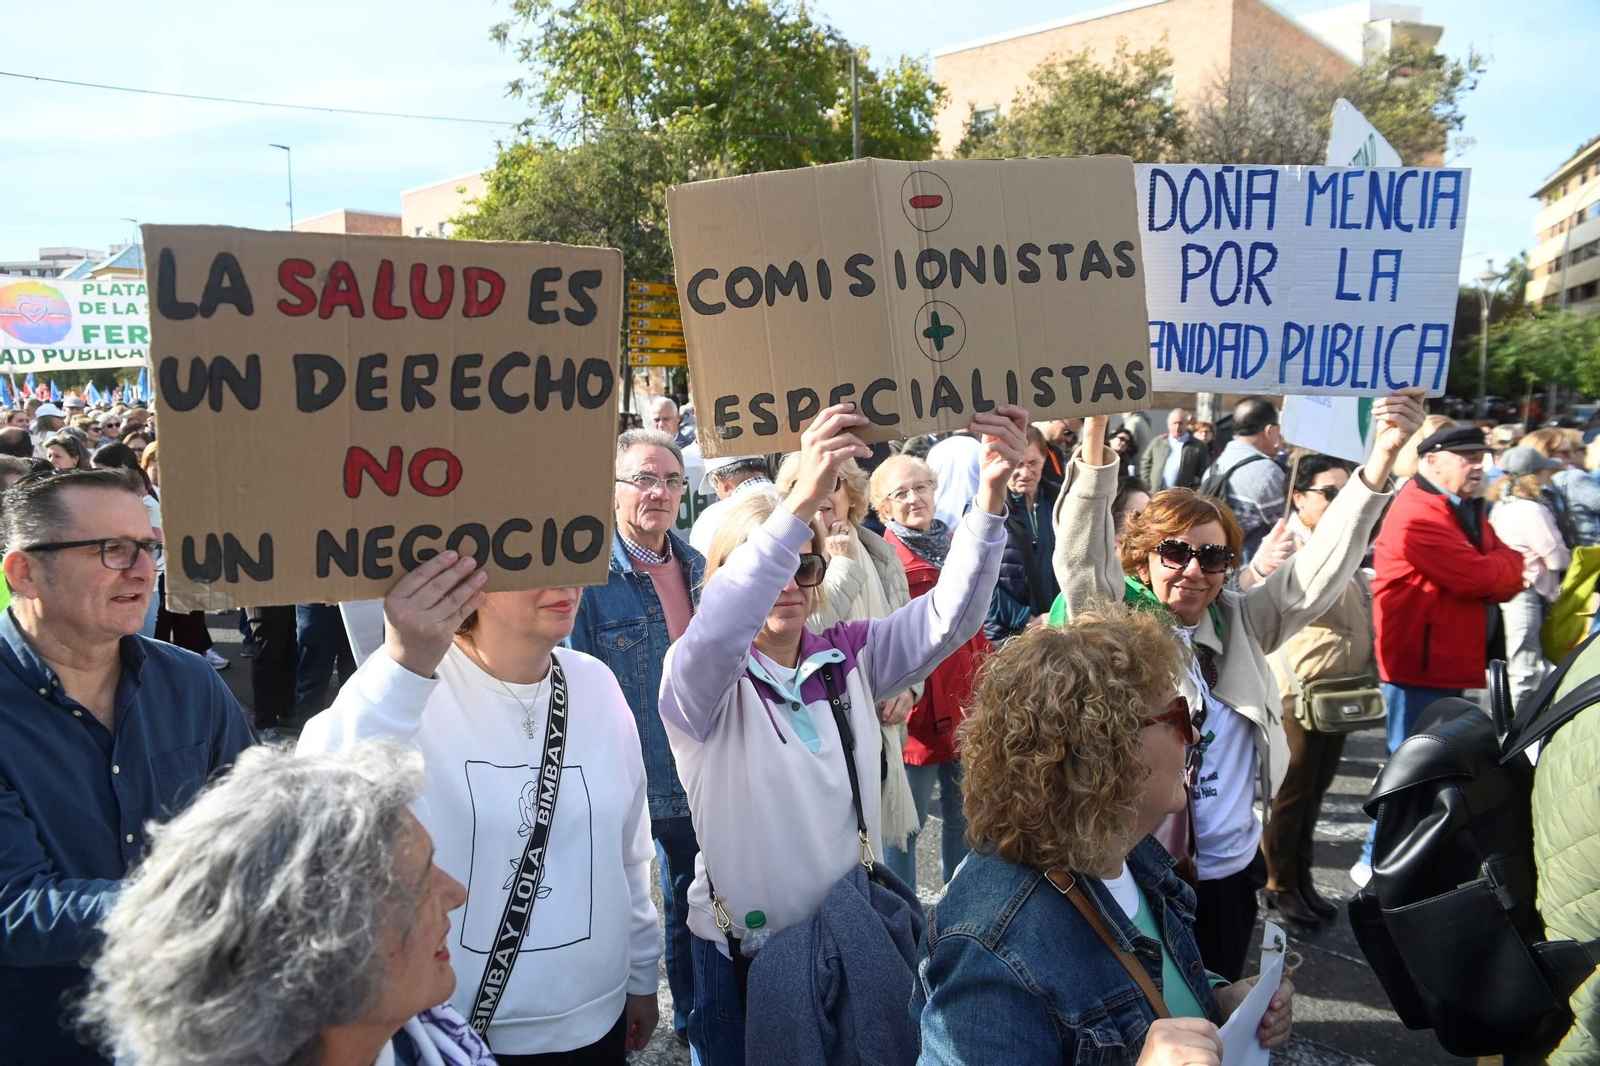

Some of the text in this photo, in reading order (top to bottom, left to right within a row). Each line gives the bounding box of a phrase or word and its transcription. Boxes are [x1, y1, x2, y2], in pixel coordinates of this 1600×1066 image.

[1147, 165, 1462, 235] DOÑA MENCIA
[79, 301, 107, 315] DE
[112, 302, 139, 315] LA
[157, 247, 603, 326] LA SALUD ES
[687, 240, 1136, 315] COMISIONISTAS
[1180, 241, 1402, 307] POR LA
[81, 324, 150, 345] FER
[1279, 321, 1450, 392] PUBLICA
[159, 351, 614, 414] UN DERECHO
[343, 445, 463, 499] NO
[181, 514, 605, 584] UN NEGOCIO
[537, 665, 566, 826] BIMBA Y LOLA
[473, 847, 543, 1035] BIMBA Y LOLA
